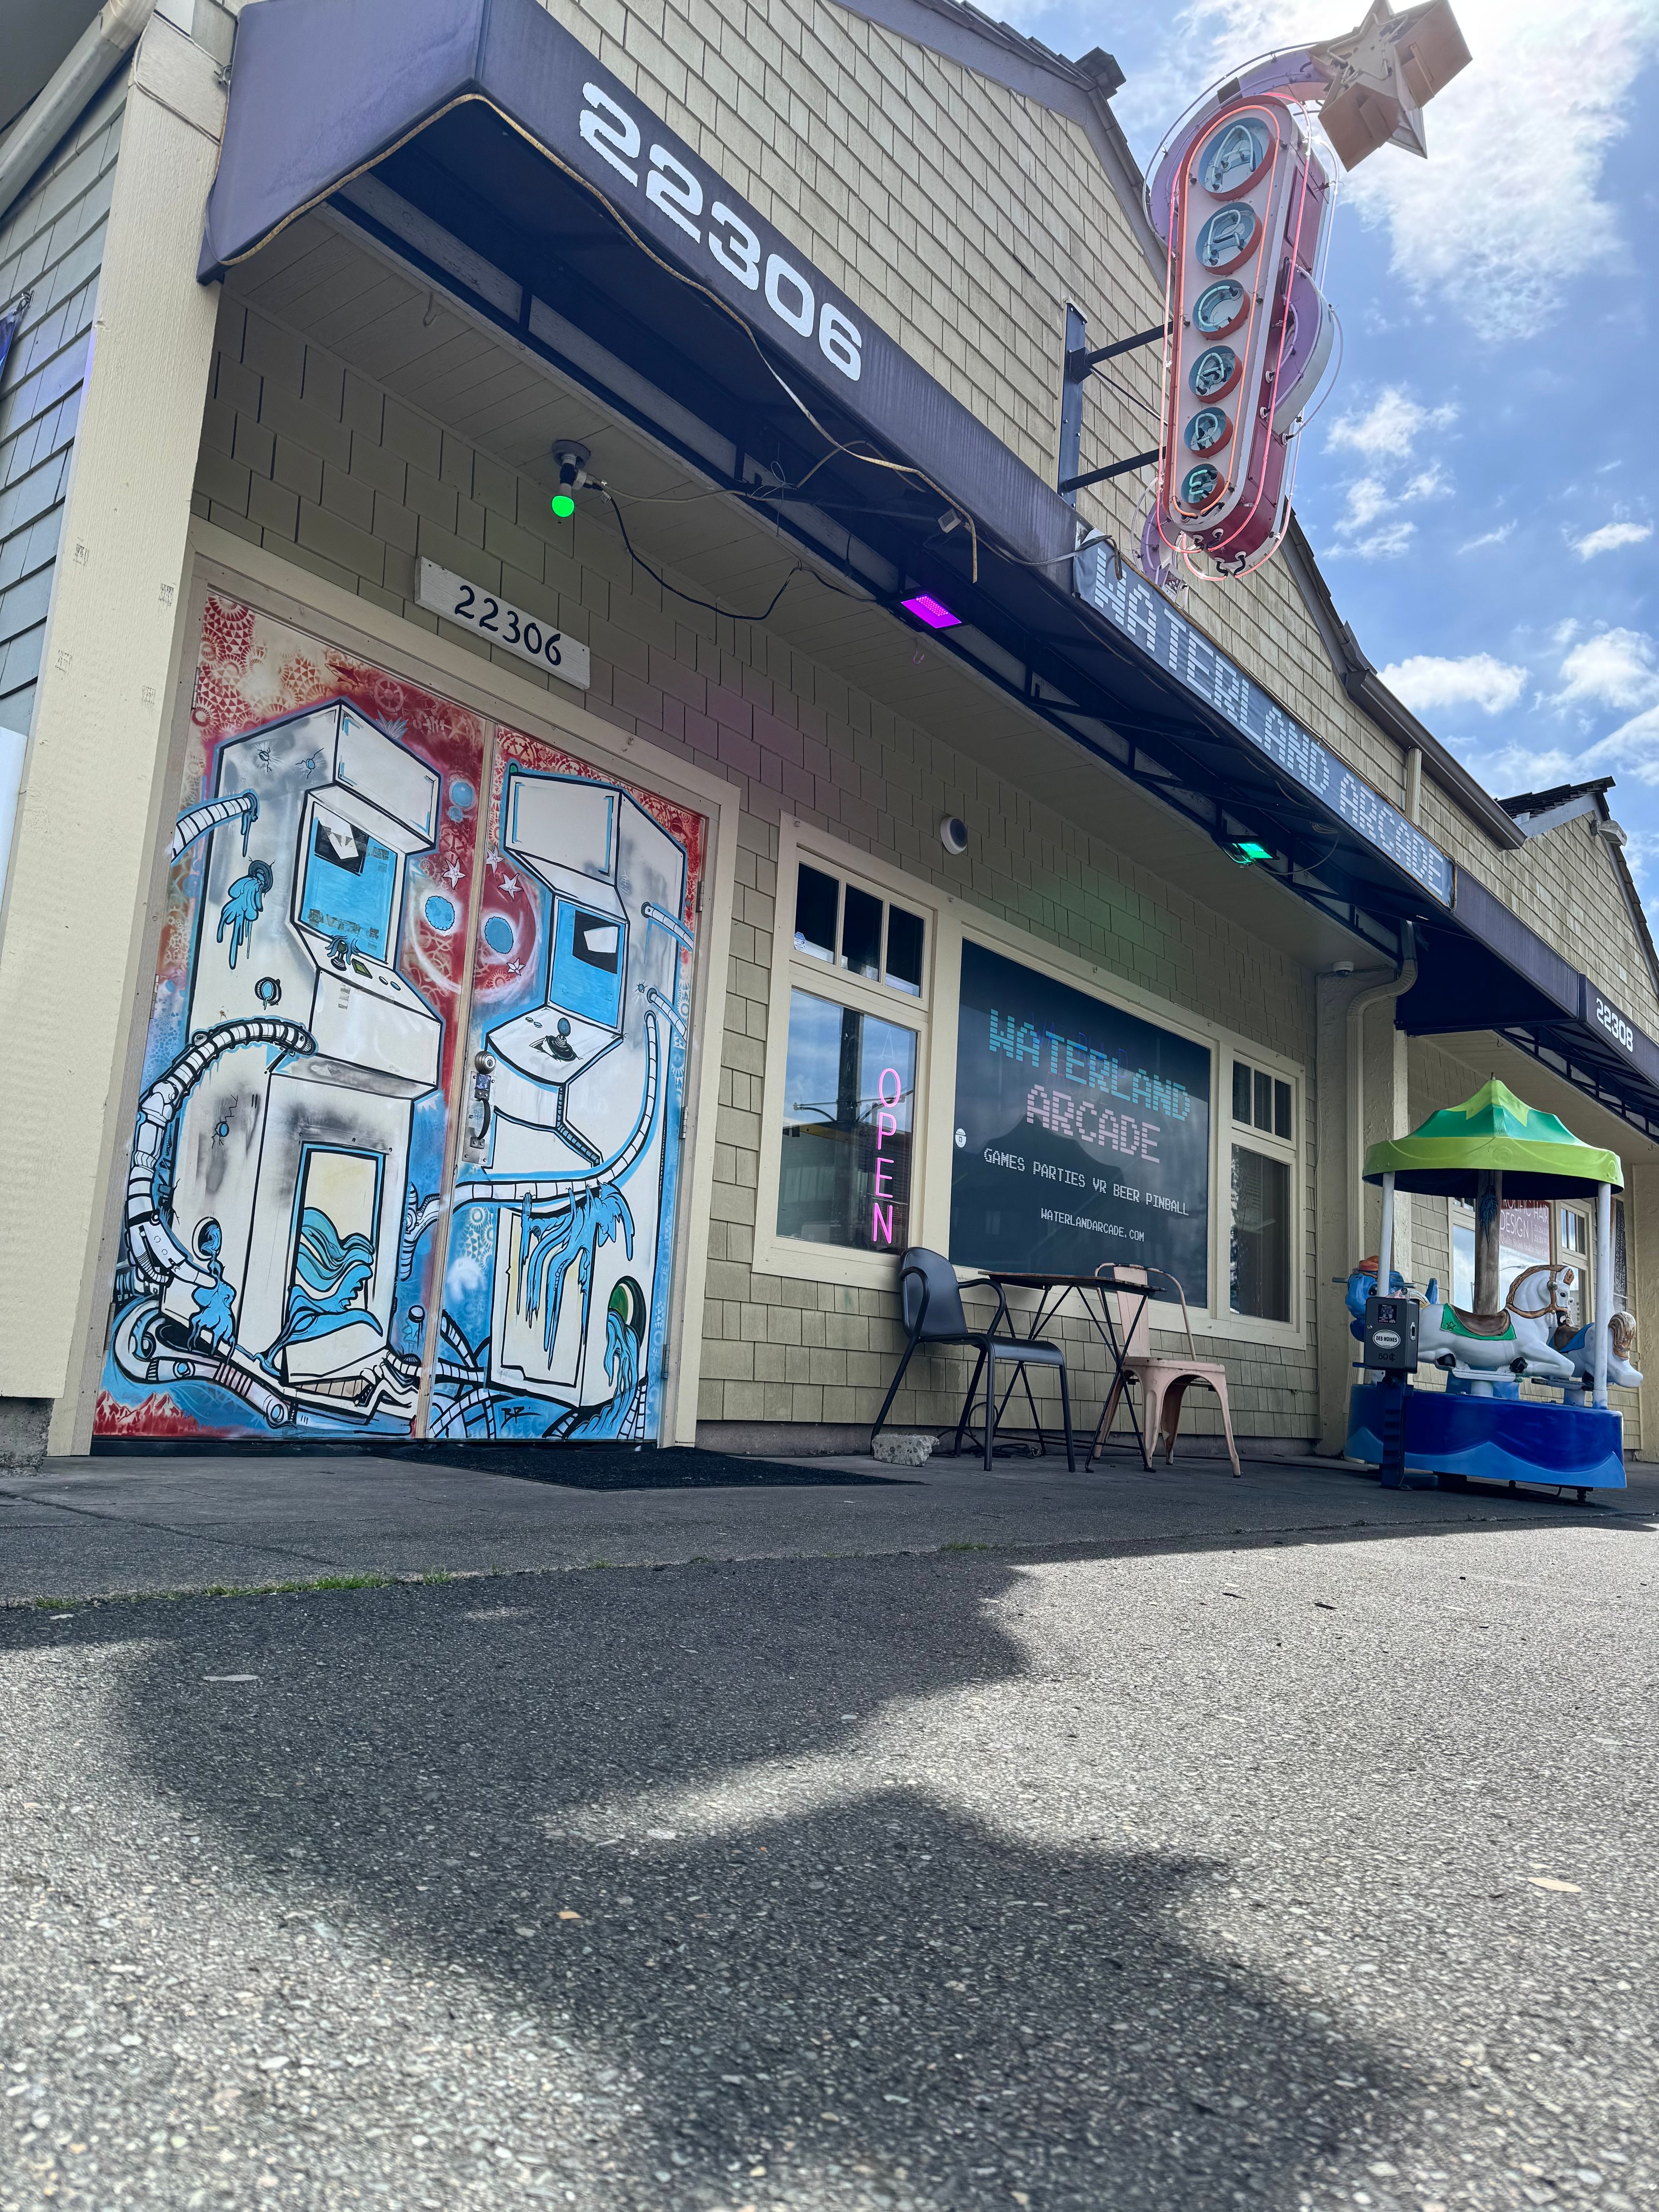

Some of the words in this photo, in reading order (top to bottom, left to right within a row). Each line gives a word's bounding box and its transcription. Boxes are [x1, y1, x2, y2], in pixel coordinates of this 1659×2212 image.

[579, 82, 862, 381] 22306
[1189, 125, 1256, 495] ARCADE
[454, 585, 561, 665] 22306
[1095, 547, 1329, 795] WATERLAND
[1340, 773, 1443, 896] ARCADE
[1596, 998, 1633, 1052] 22308
[989, 1009, 1190, 1121] WATERLAND
[873, 1068, 901, 1244] OPEN
[1027, 1084, 1160, 1163] ARCADE
[984, 1148, 1025, 1171] GAMES
[1033, 1161, 1085, 1188] PARTIES
[1093, 1178, 1106, 1194] VR
[1113, 1184, 1140, 1202] BEER
[1146, 1193, 1189, 1215] PINBALL
[1534, 1200, 1548, 1224] HAIR
[1041, 1208, 1144, 1242] WATERLANDARCADE.COM
[1500, 1210, 1529, 1239] DESIGN
[1378, 1353, 1395, 1361] 50¢
